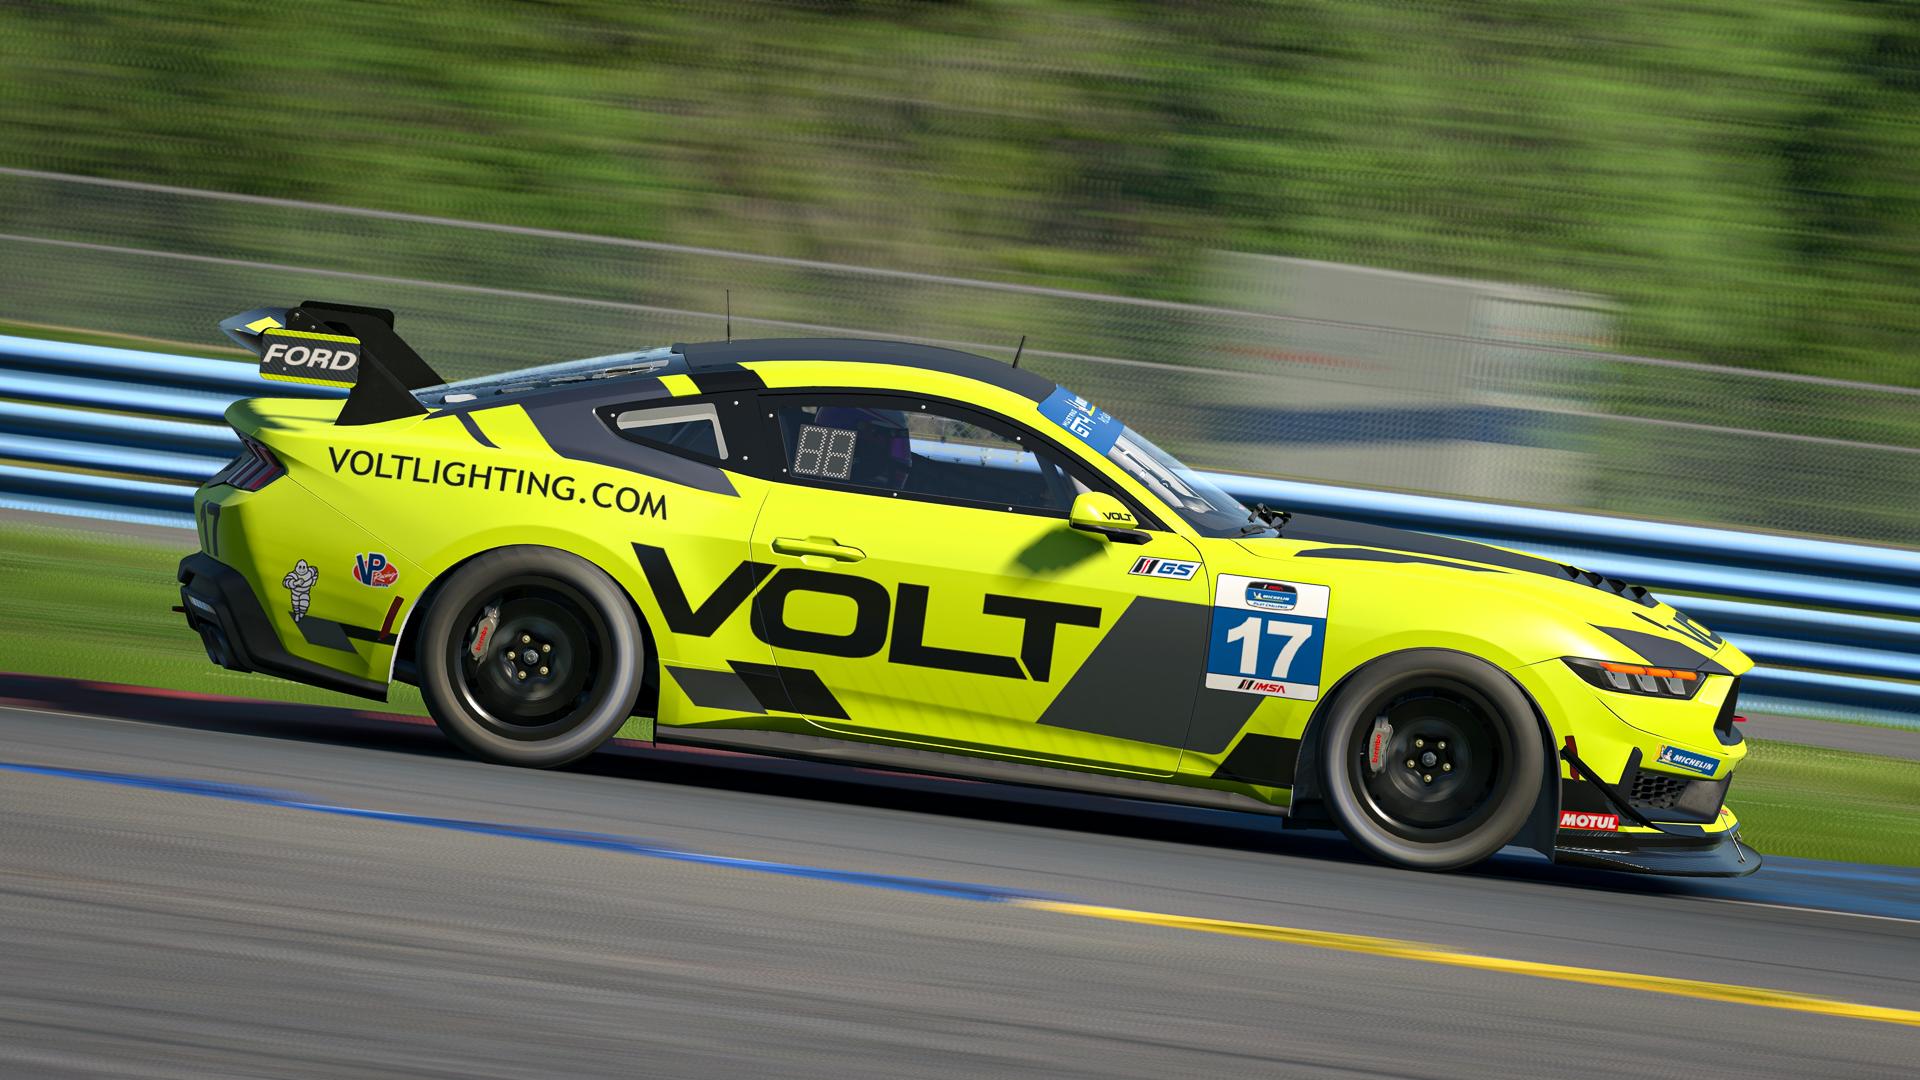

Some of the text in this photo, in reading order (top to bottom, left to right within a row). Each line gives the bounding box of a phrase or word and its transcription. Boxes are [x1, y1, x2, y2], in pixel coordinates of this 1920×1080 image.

[262, 343, 357, 371] FORD
[1069, 413, 1097, 438] GT4
[328, 446, 668, 520] VOLTLIGHTING.COM
[201, 500, 221, 557] 17
[1102, 511, 1131, 521] VOLT
[356, 552, 386, 585] VP
[1157, 562, 1194, 576] GS
[630, 542, 1101, 683] VOLT
[1227, 616, 1313, 678] 17
[1253, 682, 1286, 694] IMSA
[1372, 734, 1381, 763] brembo
[1673, 753, 1714, 771] MICHELIN
[1560, 813, 1617, 830] MOTUL
